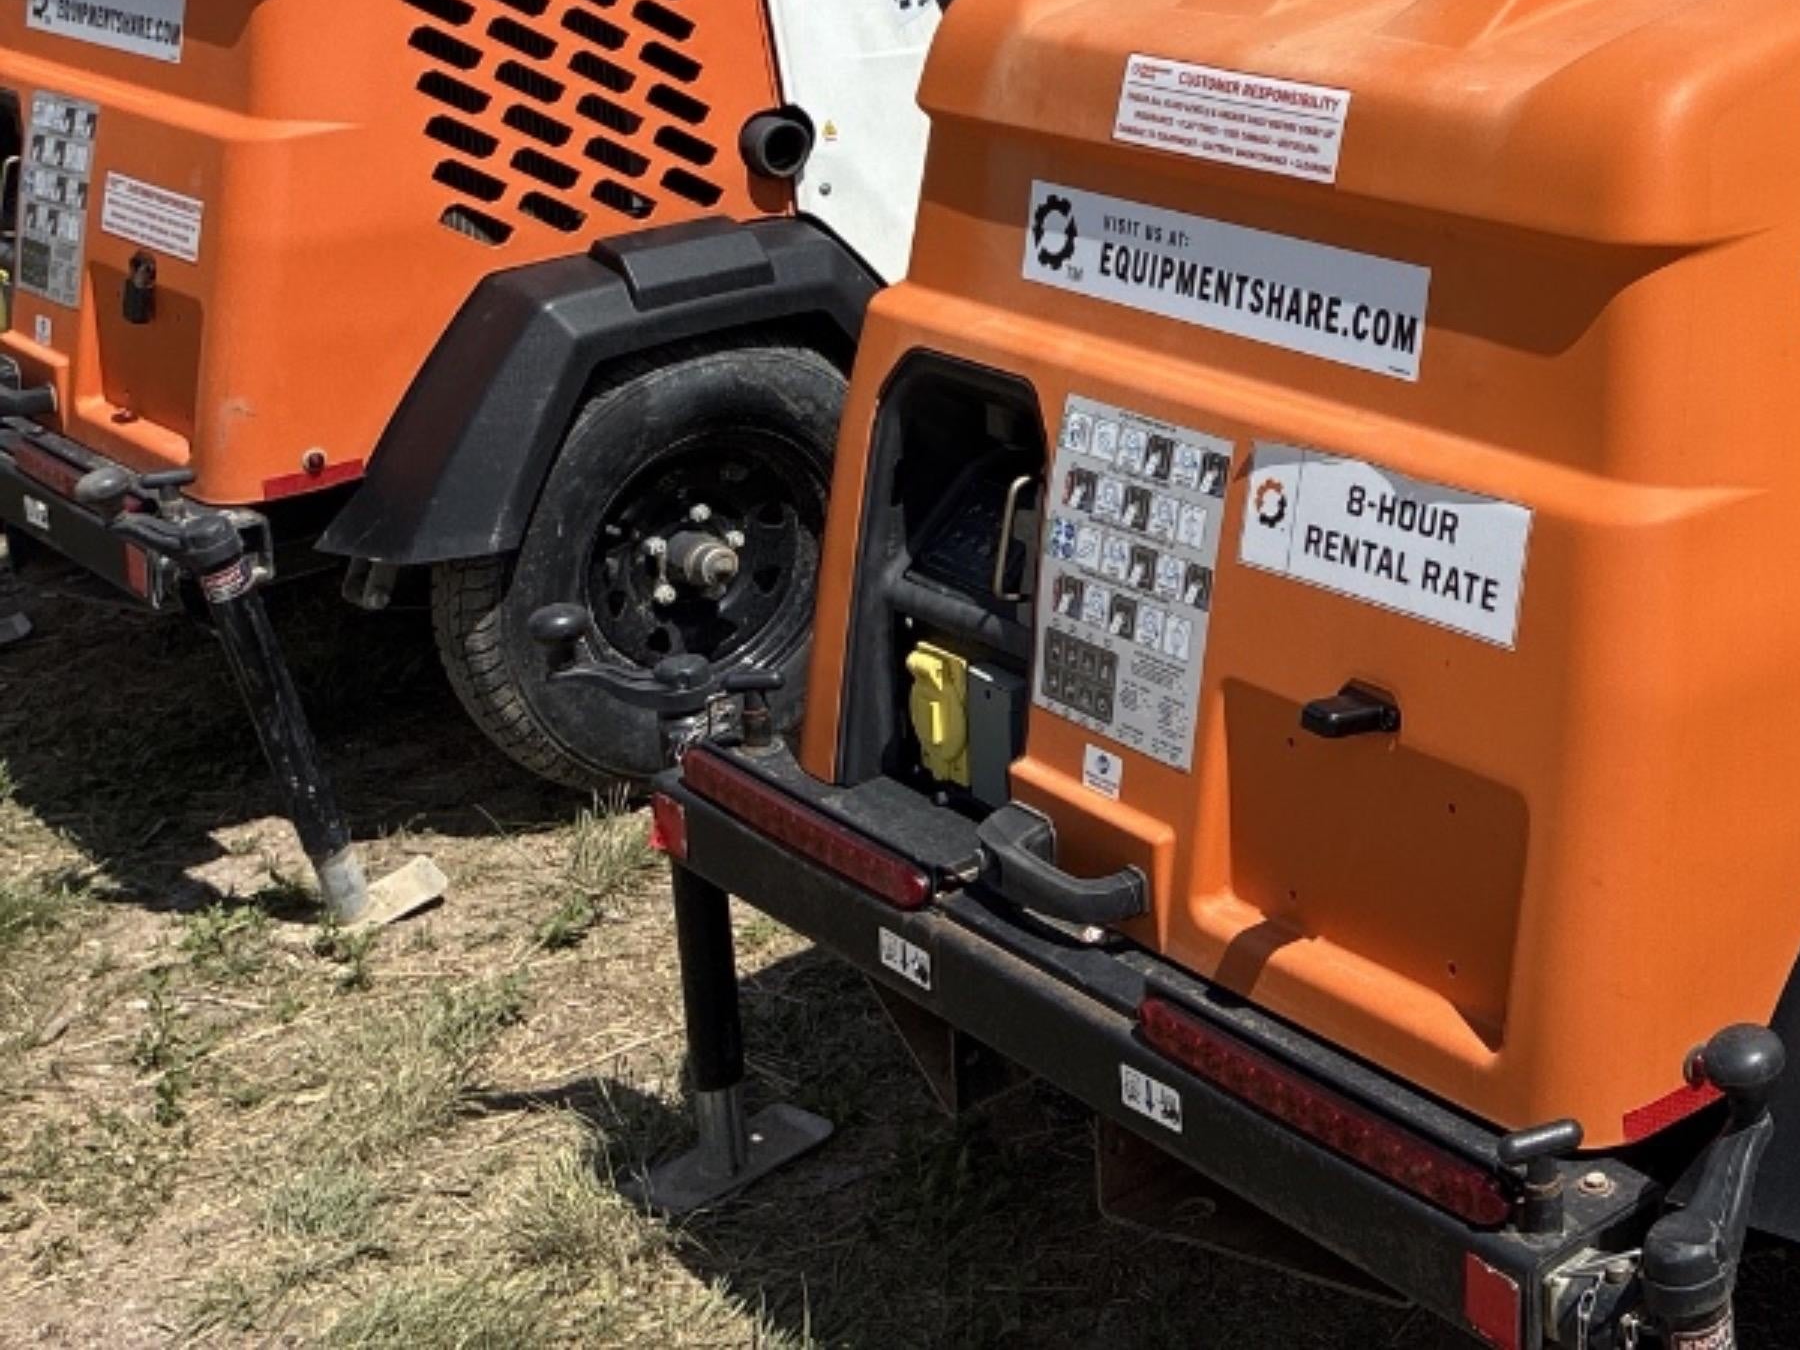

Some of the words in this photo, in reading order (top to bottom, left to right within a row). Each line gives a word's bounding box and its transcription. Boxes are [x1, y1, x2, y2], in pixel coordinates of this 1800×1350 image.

[1103, 214, 1140, 237] VISIT
[1145, 224, 1162, 242] US
[1100, 241, 1418, 355] EQUIPMENTSHARE.COM
[1346, 484, 1459, 545] 8-HOUR
[1304, 524, 1410, 585] RENTAL
[1421, 556, 1500, 612] RATE
